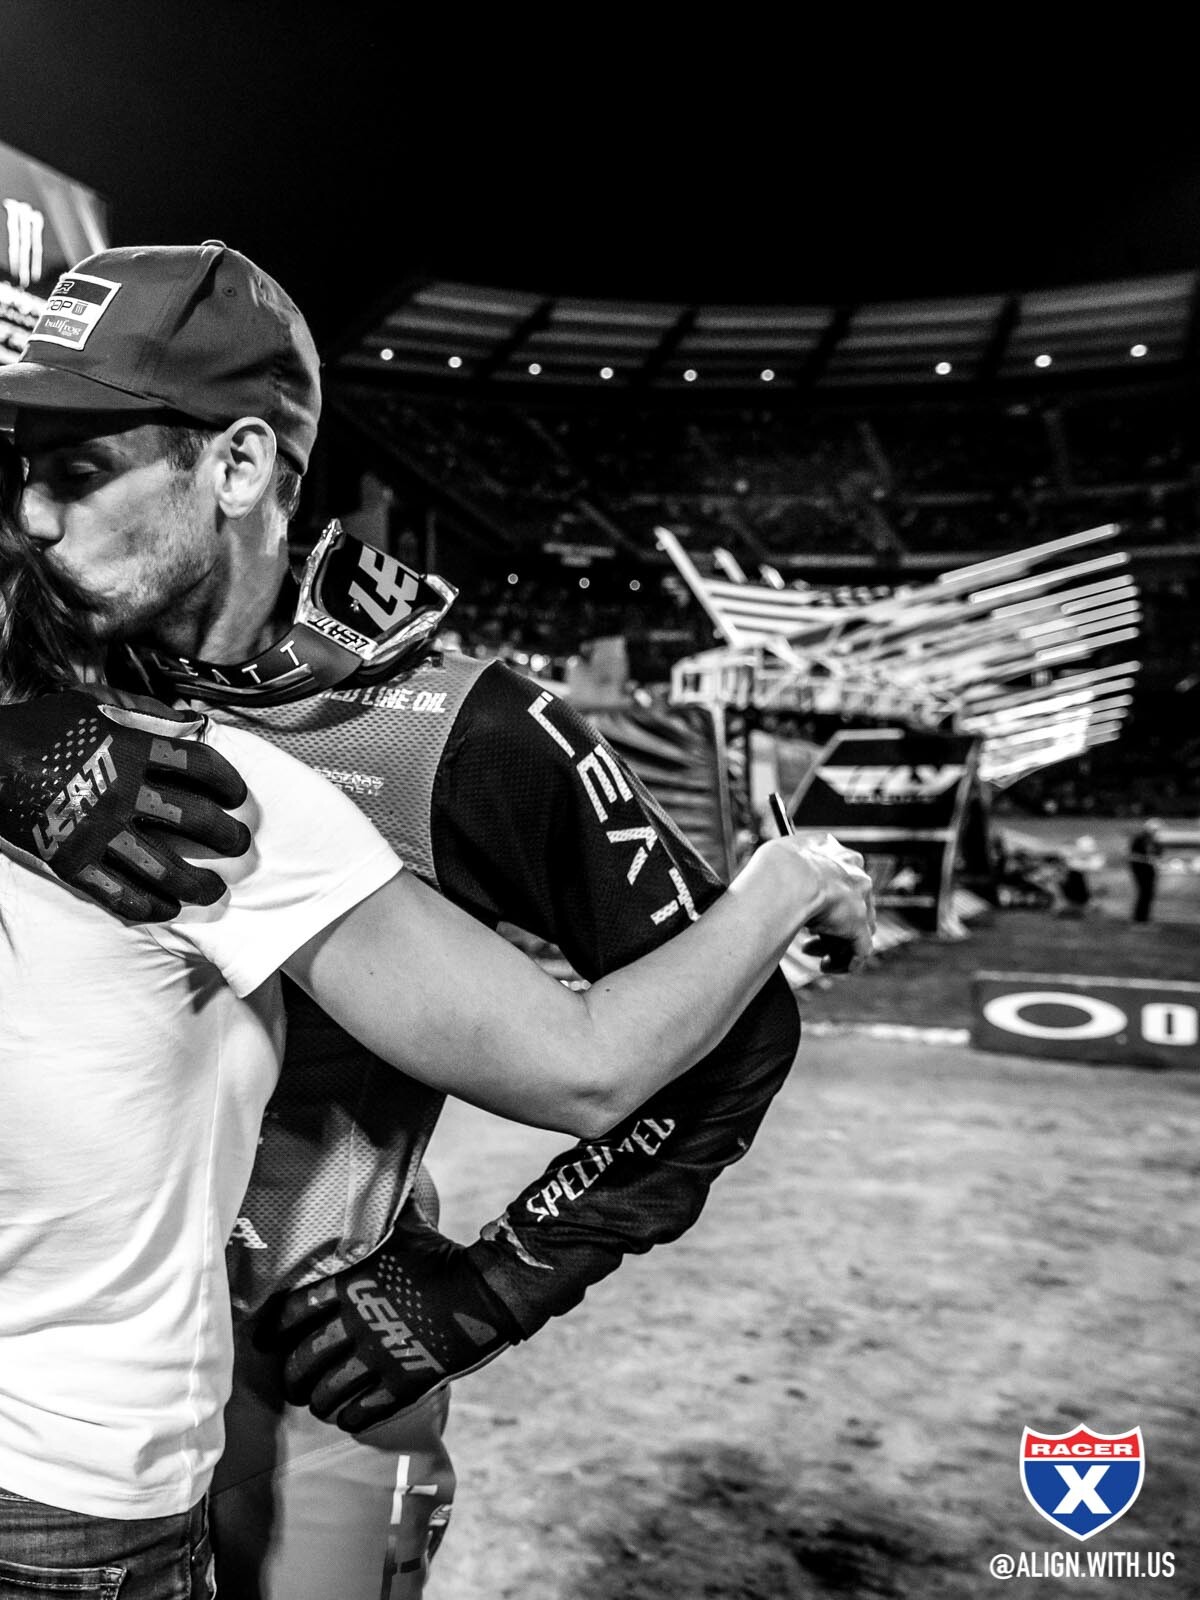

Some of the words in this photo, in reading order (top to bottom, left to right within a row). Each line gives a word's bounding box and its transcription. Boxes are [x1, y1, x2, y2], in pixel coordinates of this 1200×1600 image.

[362, 686, 414, 711] LINE
[412, 691, 448, 713] OIL
[32, 734, 118, 861] LEATT
[346, 1279, 446, 1374] LEATT
